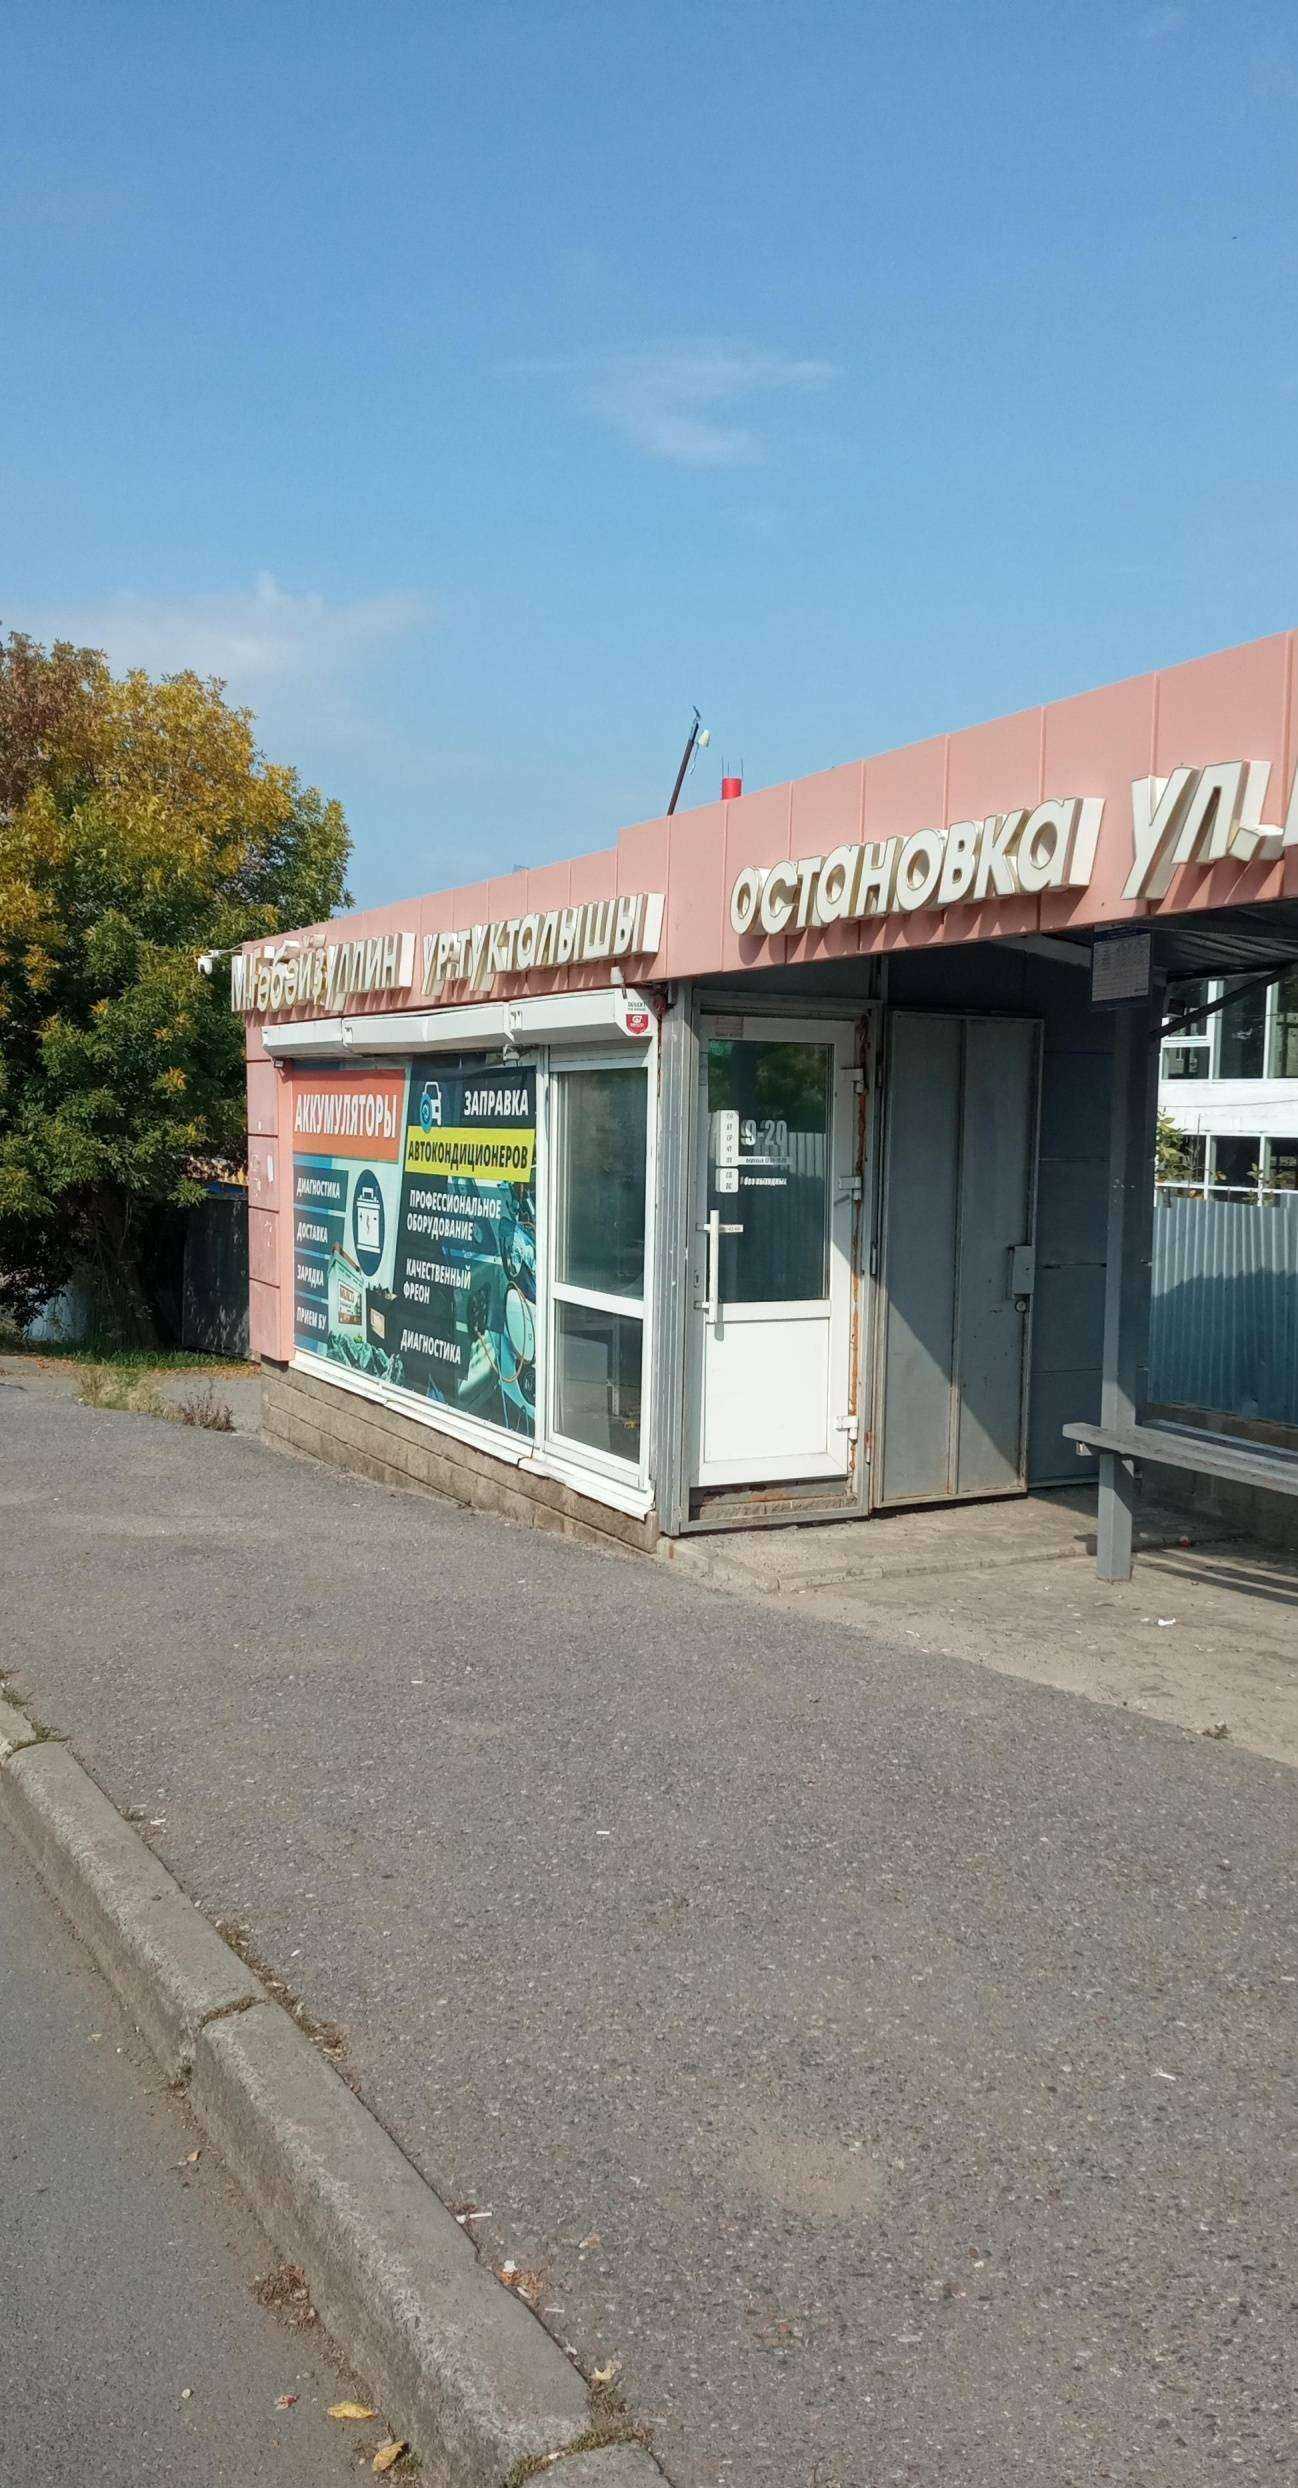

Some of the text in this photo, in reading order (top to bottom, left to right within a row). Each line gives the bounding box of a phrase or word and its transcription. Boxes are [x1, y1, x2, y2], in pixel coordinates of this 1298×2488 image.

[294, 1093, 397, 1139] АККУМУЛЯТОРЫ
[464, 1089, 529, 1117] ЗАПРАВКА
[408, 1140, 528, 1172] АВТОКОНДИЦИОНЕРОВ
[296, 1177, 341, 1200] ДИАГНОСТИКА
[409, 1189, 501, 1219] ПРОФЕССИОНАЛЬНОЕ
[296, 1221, 329, 1244] ДОСТАВКА
[406, 1215, 474, 1241] ОБОРУДОВАНИЕ
[296, 1264, 325, 1289] ЗАРЯДКА
[406, 1258, 472, 1290] КАЧЕСТВЕННЫЙ
[403, 1280, 431, 1305] ФРЕОН
[400, 1329, 462, 1365] ДИАГНОСТИКА
